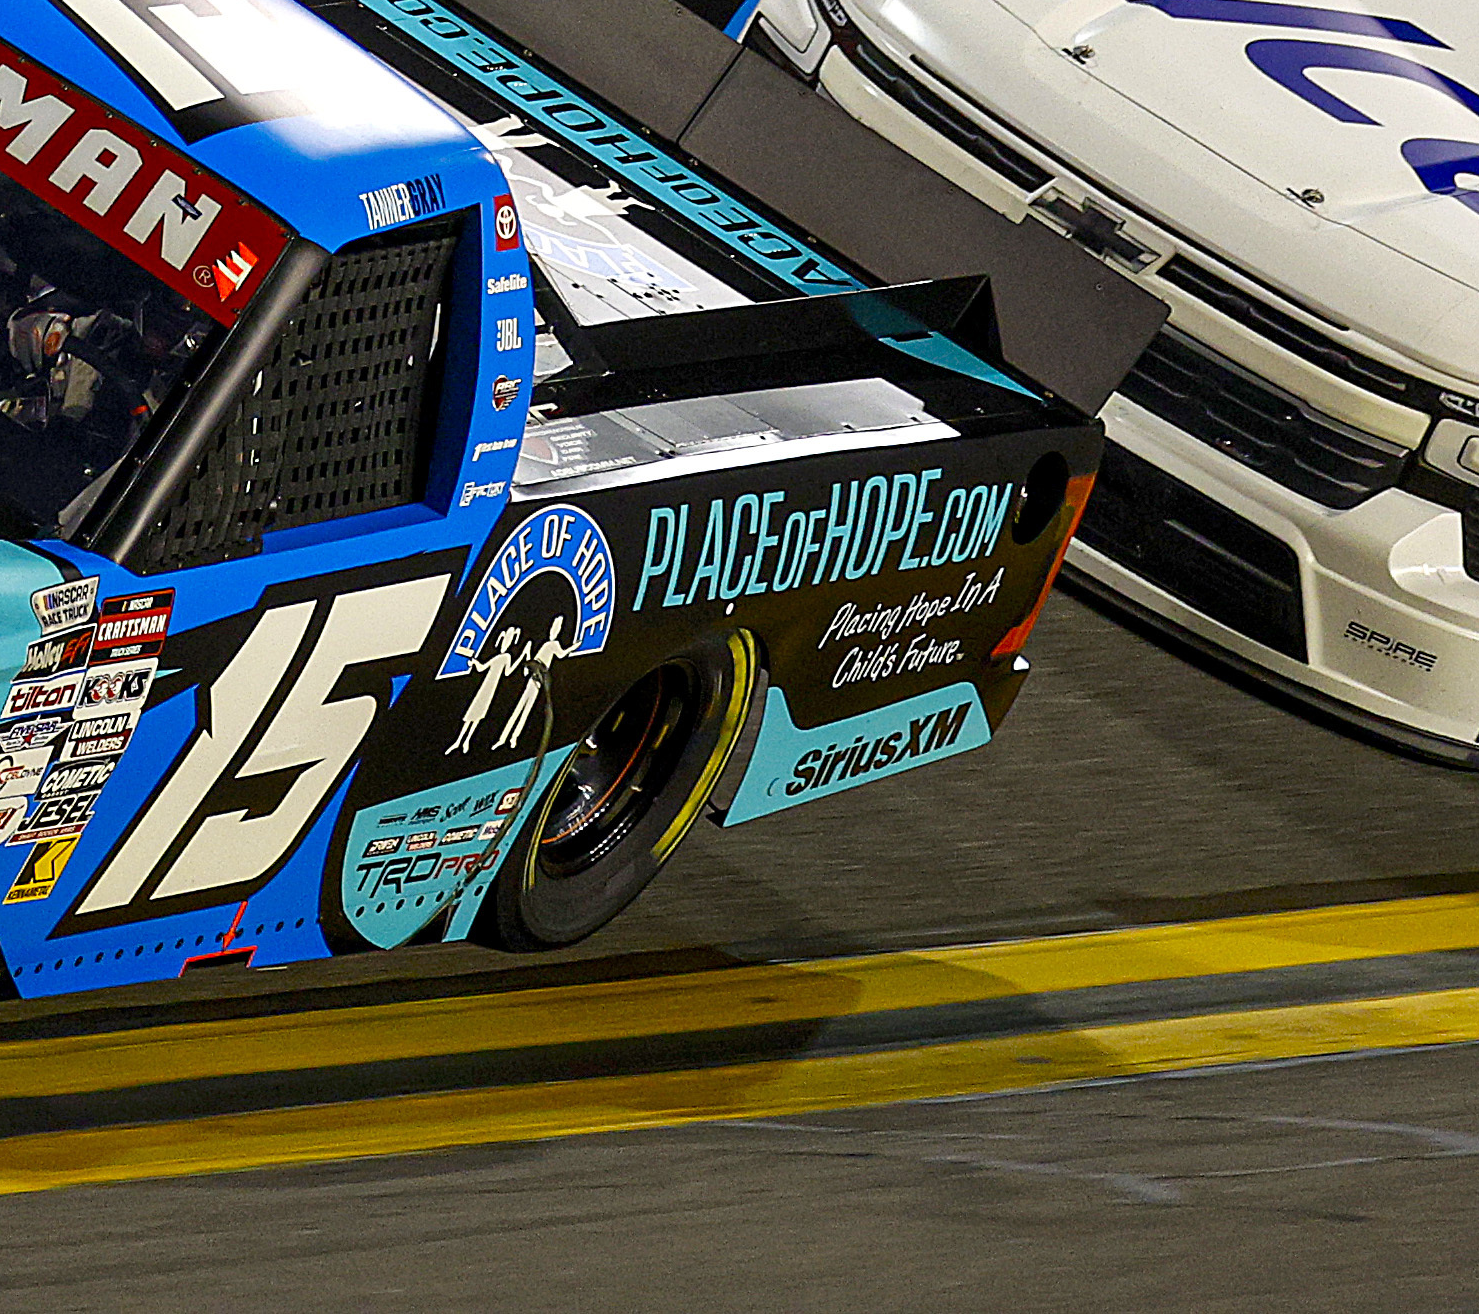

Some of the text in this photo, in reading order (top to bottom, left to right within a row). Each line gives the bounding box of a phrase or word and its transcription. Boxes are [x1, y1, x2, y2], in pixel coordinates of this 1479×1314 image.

[359, 173, 446, 231] TANNER GRAY
[487, 273, 528, 295] Safelite
[496, 317, 523, 351] JBL
[43, 585, 89, 611] NASCAR
[454, 514, 609, 656] PLACE OF HOPE
[63, 604, 88, 623] TRUCK
[819, 567, 1005, 651] Placing Hope In A
[98, 614, 166, 641] CRAFTSMAN
[23, 641, 64, 673] Holley
[11, 684, 78, 713] tilton
[76, 669, 151, 709] KOOKS
[74, 716, 128, 740] LINCOLN
[75, 573, 452, 915] 15
[76, 736, 125, 757] WELDERS
[784, 700, 974, 798] SiriusXM
[41, 762, 116, 794] COMETIC
[18, 792, 96, 831] JESEL
